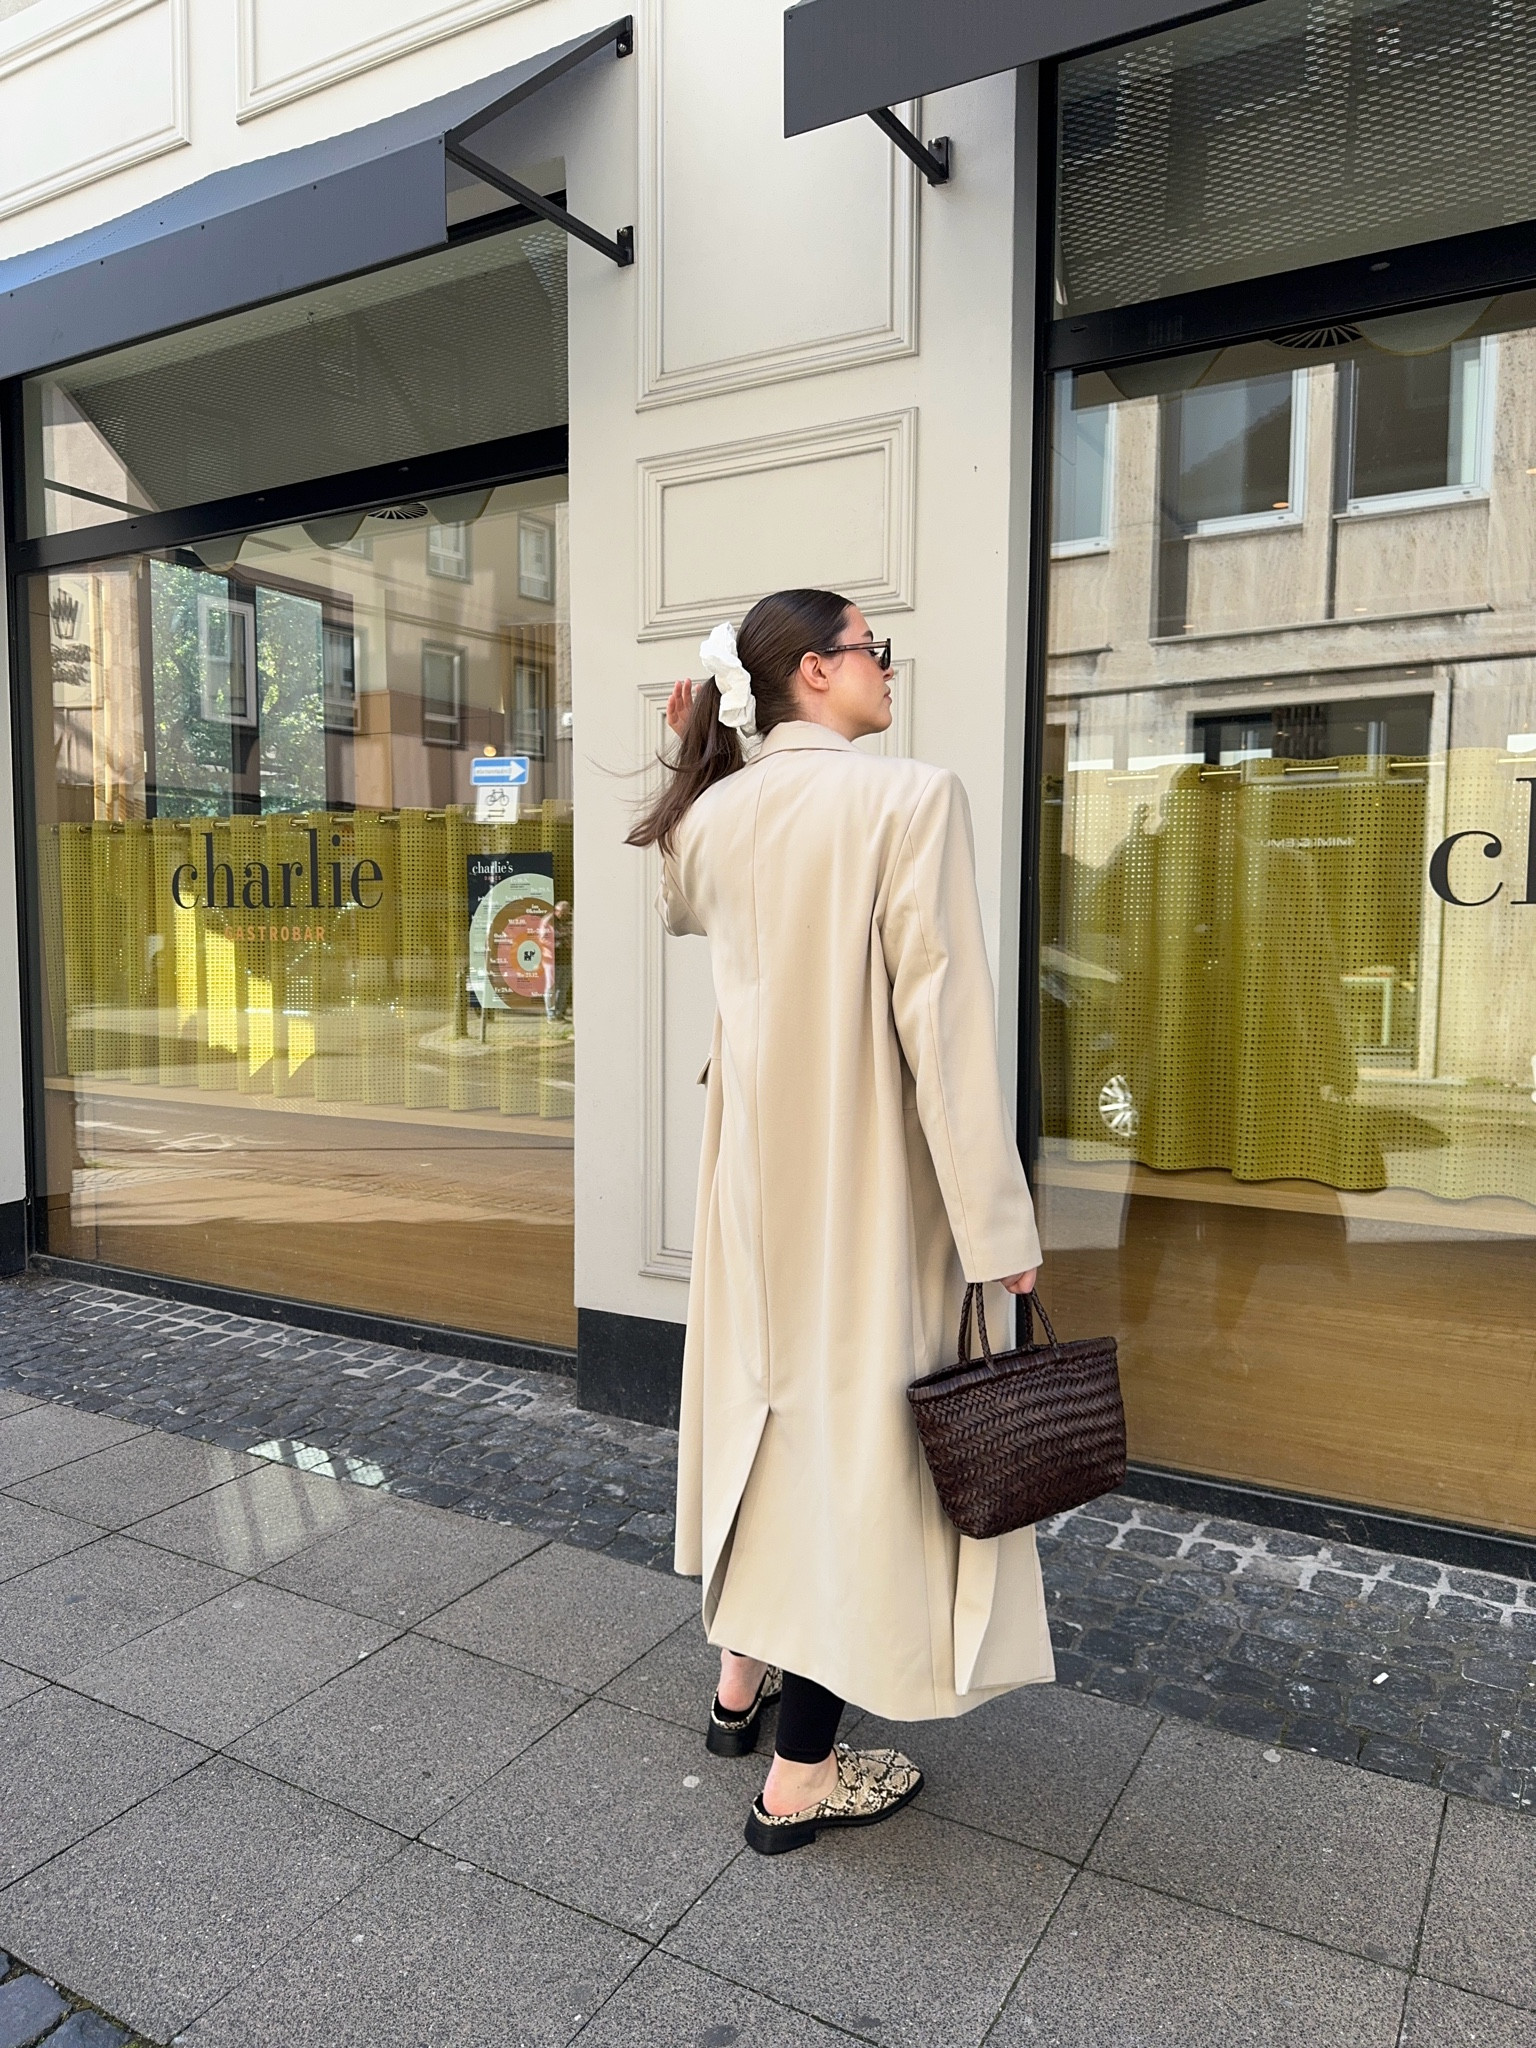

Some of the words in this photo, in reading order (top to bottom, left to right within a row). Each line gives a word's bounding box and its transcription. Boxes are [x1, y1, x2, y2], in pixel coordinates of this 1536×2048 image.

[1429, 778, 1536, 906] c
[172, 828, 383, 909] charlie
[472, 861, 514, 873] charlie's
[224, 926, 326, 942] GASTROBAR
